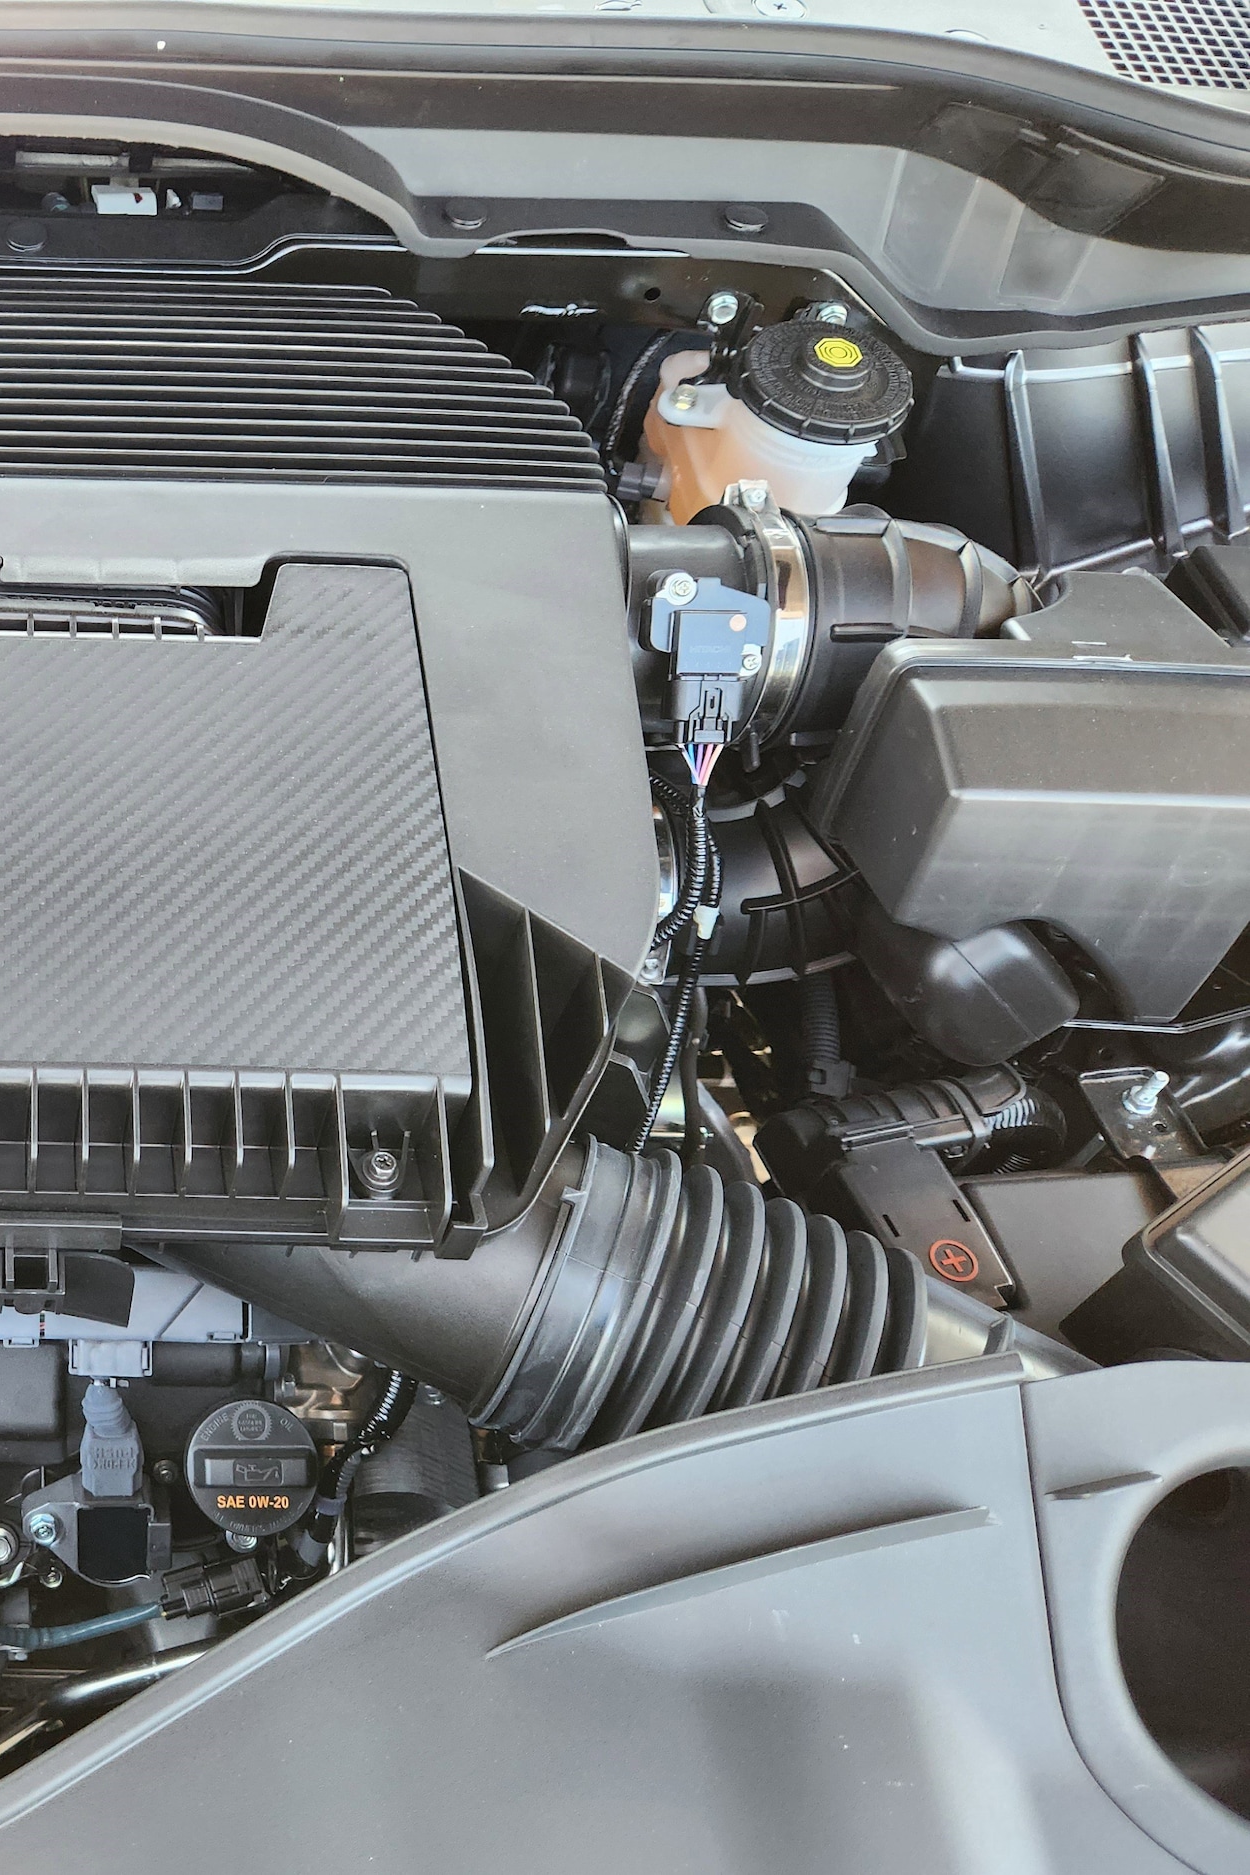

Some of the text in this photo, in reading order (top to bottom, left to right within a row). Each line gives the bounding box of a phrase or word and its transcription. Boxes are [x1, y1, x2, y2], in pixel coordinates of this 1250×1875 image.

[201, 1412, 295, 1442] ENGINE OIL
[217, 1495, 289, 1509] SAE 0W-20
